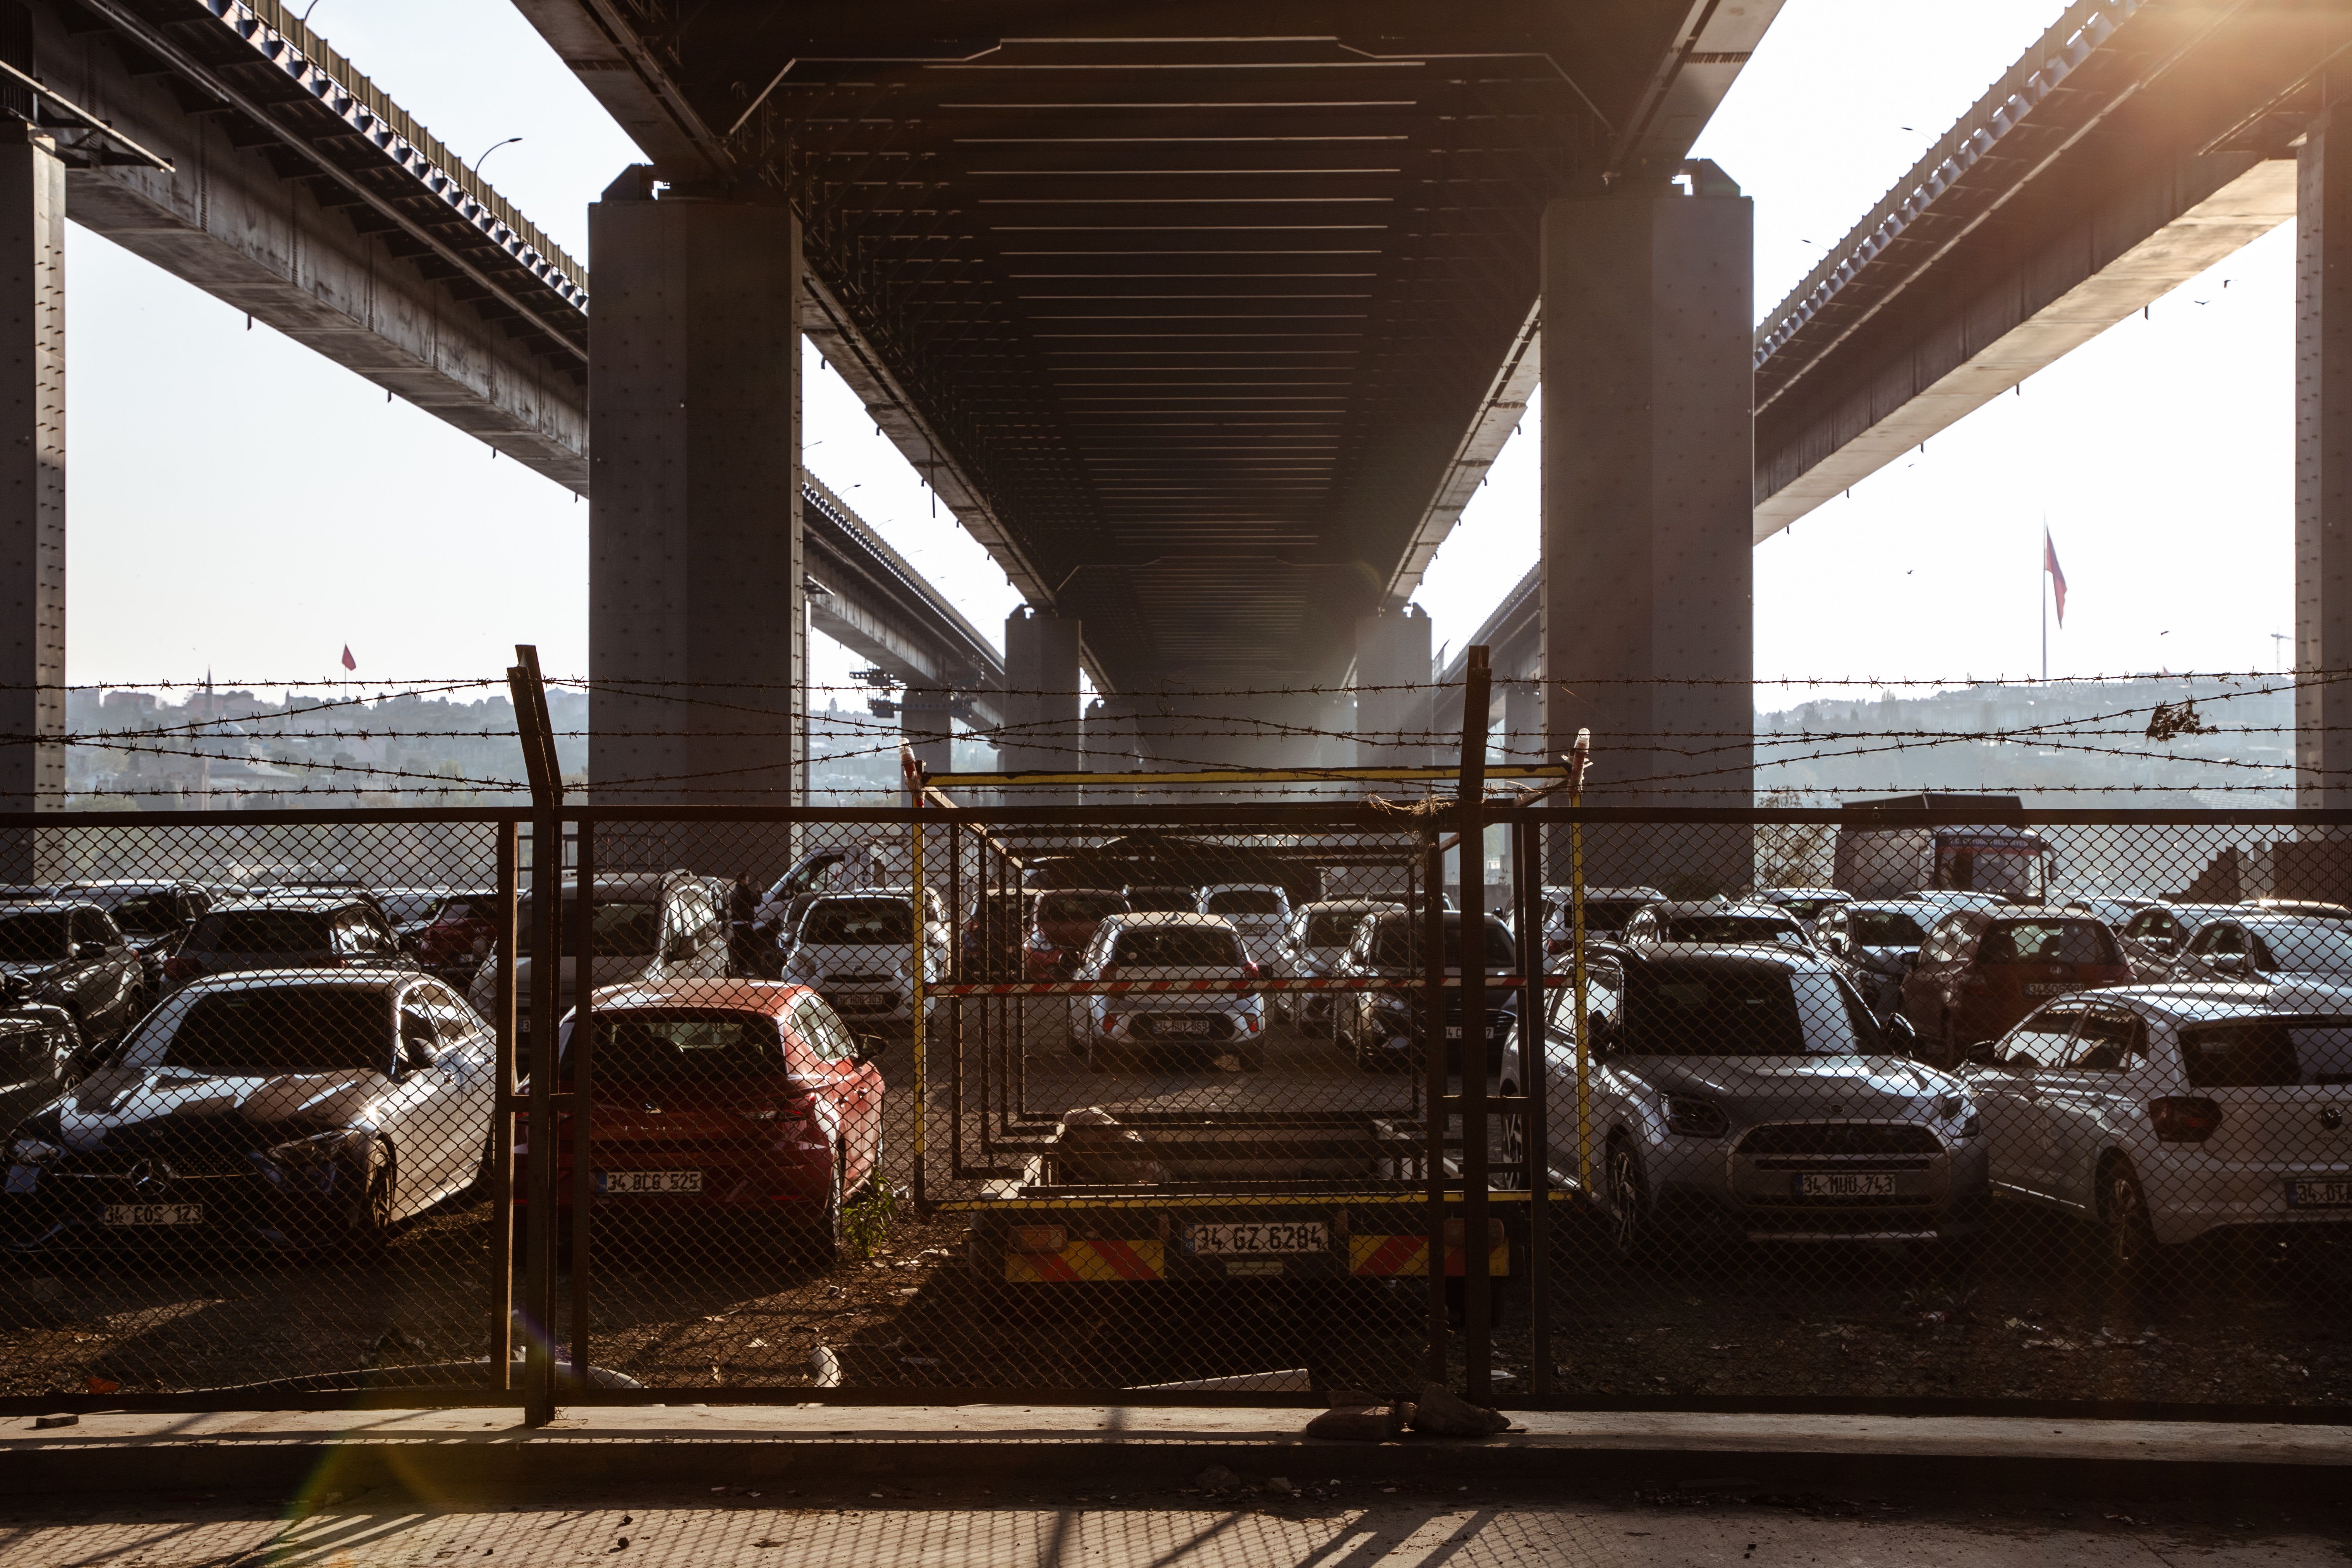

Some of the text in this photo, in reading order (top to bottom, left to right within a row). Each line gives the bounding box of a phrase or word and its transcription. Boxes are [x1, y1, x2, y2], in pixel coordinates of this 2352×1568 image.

[608, 1174, 626, 1190] 34
[633, 1174, 660, 1190] BCG
[670, 1174, 698, 1190] 525
[1804, 1177, 1820, 1193] 34
[1866, 1177, 1892, 1193] 743
[2298, 1185, 2316, 1201] 34
[105, 1206, 123, 1223] 34
[174, 1205, 201, 1222] 123
[1197, 1227, 1223, 1250] 34
[1234, 1227, 1259, 1250] GZ
[1270, 1226, 1322, 1249] 6284
